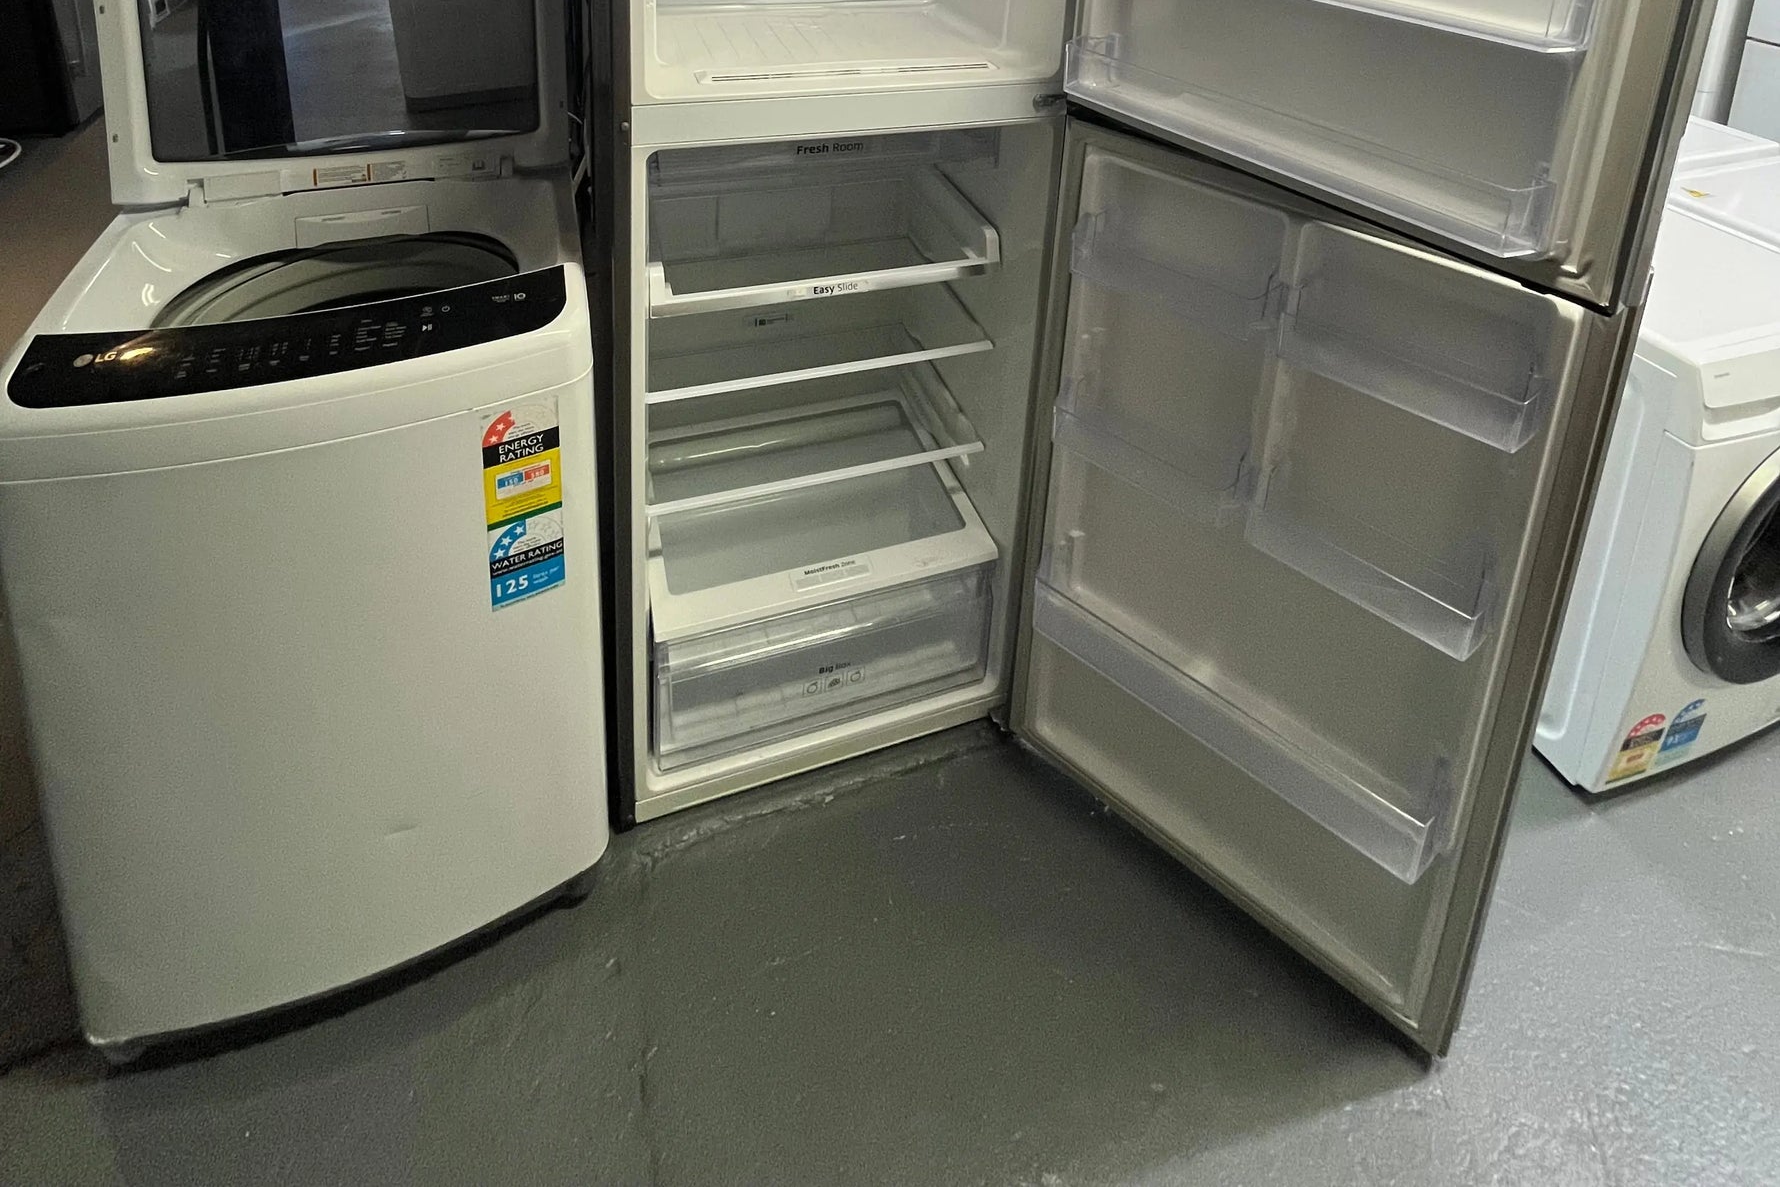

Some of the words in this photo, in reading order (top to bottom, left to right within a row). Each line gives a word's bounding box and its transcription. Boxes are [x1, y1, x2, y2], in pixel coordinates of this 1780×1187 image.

[796, 144, 829, 155] Fresh
[832, 141, 864, 153] Room
[813, 285, 835, 295] Easy
[838, 282, 858, 292] Slide
[94, 351, 118, 363] LG
[498, 434, 544, 454] ENERGY
[499, 443, 544, 463] RATING
[492, 553, 526, 571] WATER
[528, 540, 563, 557] RATING
[496, 574, 529, 598] 125
[818, 665, 834, 674] Big
